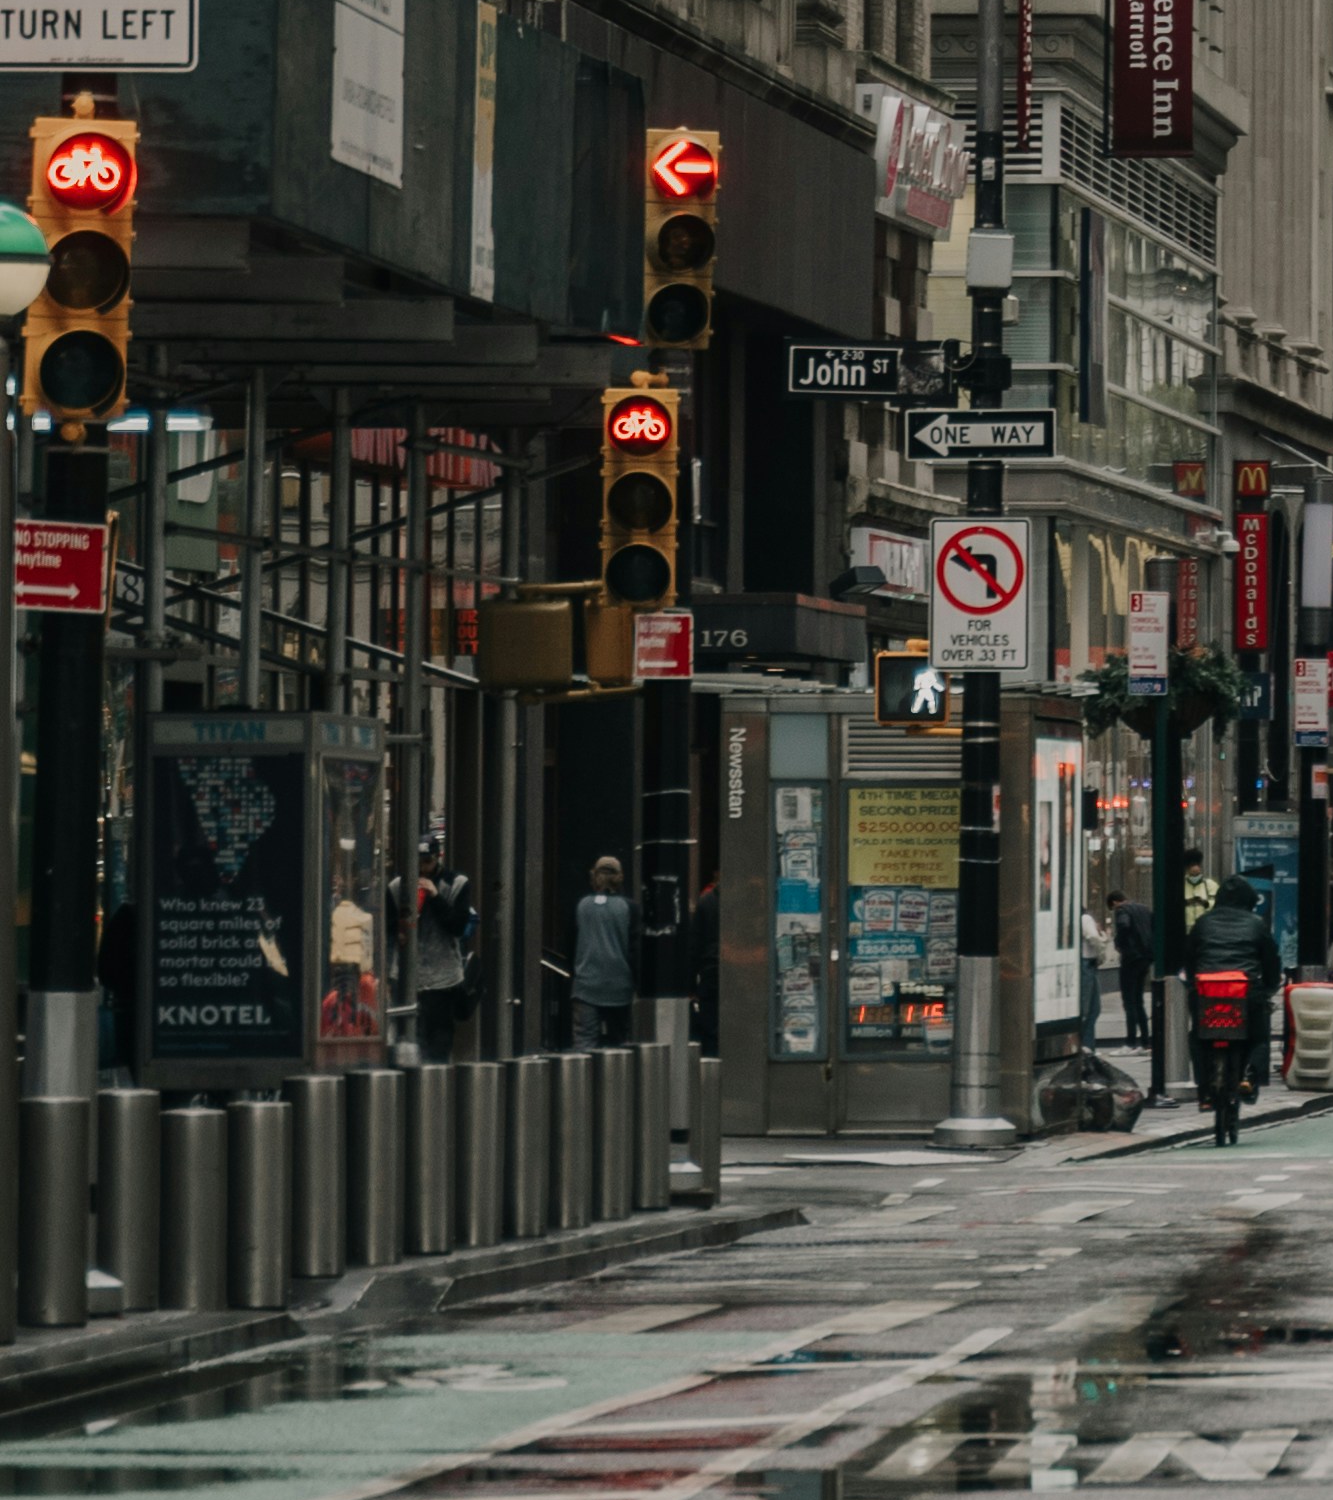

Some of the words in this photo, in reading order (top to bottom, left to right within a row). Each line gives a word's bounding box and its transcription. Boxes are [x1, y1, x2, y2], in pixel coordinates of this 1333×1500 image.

[0, 9, 82, 40] TURN
[102, 9, 176, 40] LEFT
[1153, 78, 1179, 139] Inn
[841, 349, 865, 361] 2-30
[799, 357, 866, 387] John
[872, 358, 890, 375] ST
[929, 426, 971, 445] ONE
[991, 425, 1035, 444] WAY
[15, 529, 31, 548] NO
[33, 531, 90, 551] STOPPING
[16, 551, 62, 570] Anytime
[1242, 517, 1261, 646] McDonald's
[967, 619, 992, 632] FOR
[701, 629, 748, 648] 176
[950, 634, 1010, 647] VEHICLES
[942, 649, 974, 662] OVER
[1001, 649, 1017, 662] FT
[191, 722, 267, 742] TITAN
[728, 727, 747, 819] Newsstan
[859, 805, 918, 817] SECOND
[920, 804, 959, 816] PRIZE
[159, 897, 197, 912] Who
[200, 897, 242, 912] knew
[246, 897, 265, 912] 23
[159, 919, 215, 934] square
[219, 916, 261, 930] miles
[265, 916, 283, 930] of
[159, 935, 198, 949] solid
[201, 935, 241, 949] brick
[160, 955, 216, 969] mortar
[219, 954, 262, 968] could
[159, 976, 179, 988] so
[181, 972, 250, 987] flexible?
[158, 1004, 272, 1026] KNOTEL
